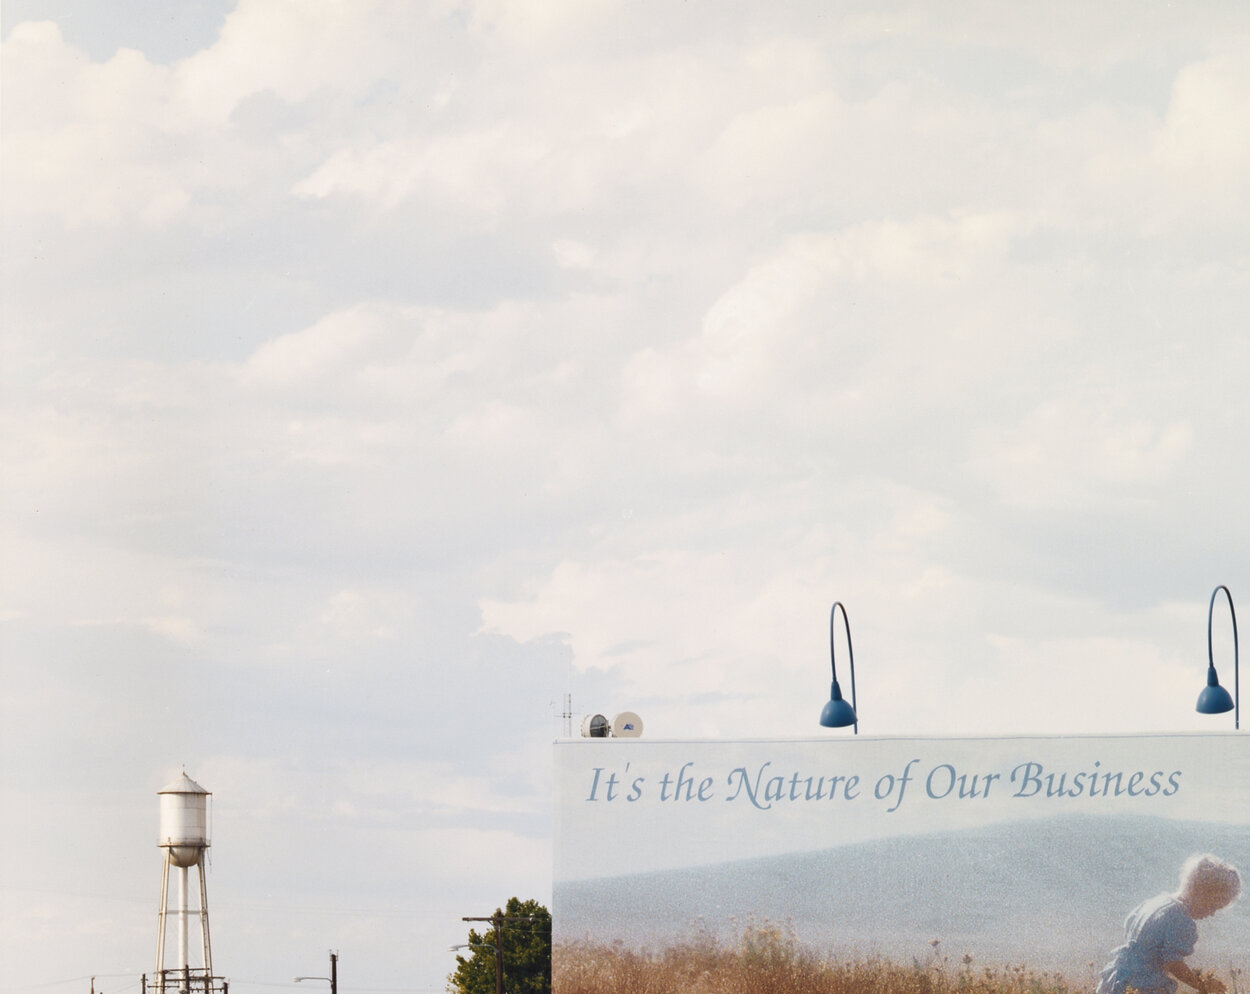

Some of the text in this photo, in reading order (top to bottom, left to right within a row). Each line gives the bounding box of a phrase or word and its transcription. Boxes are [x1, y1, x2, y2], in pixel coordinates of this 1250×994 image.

[585, 759, 1182, 812] It's the Nature of Our Business
